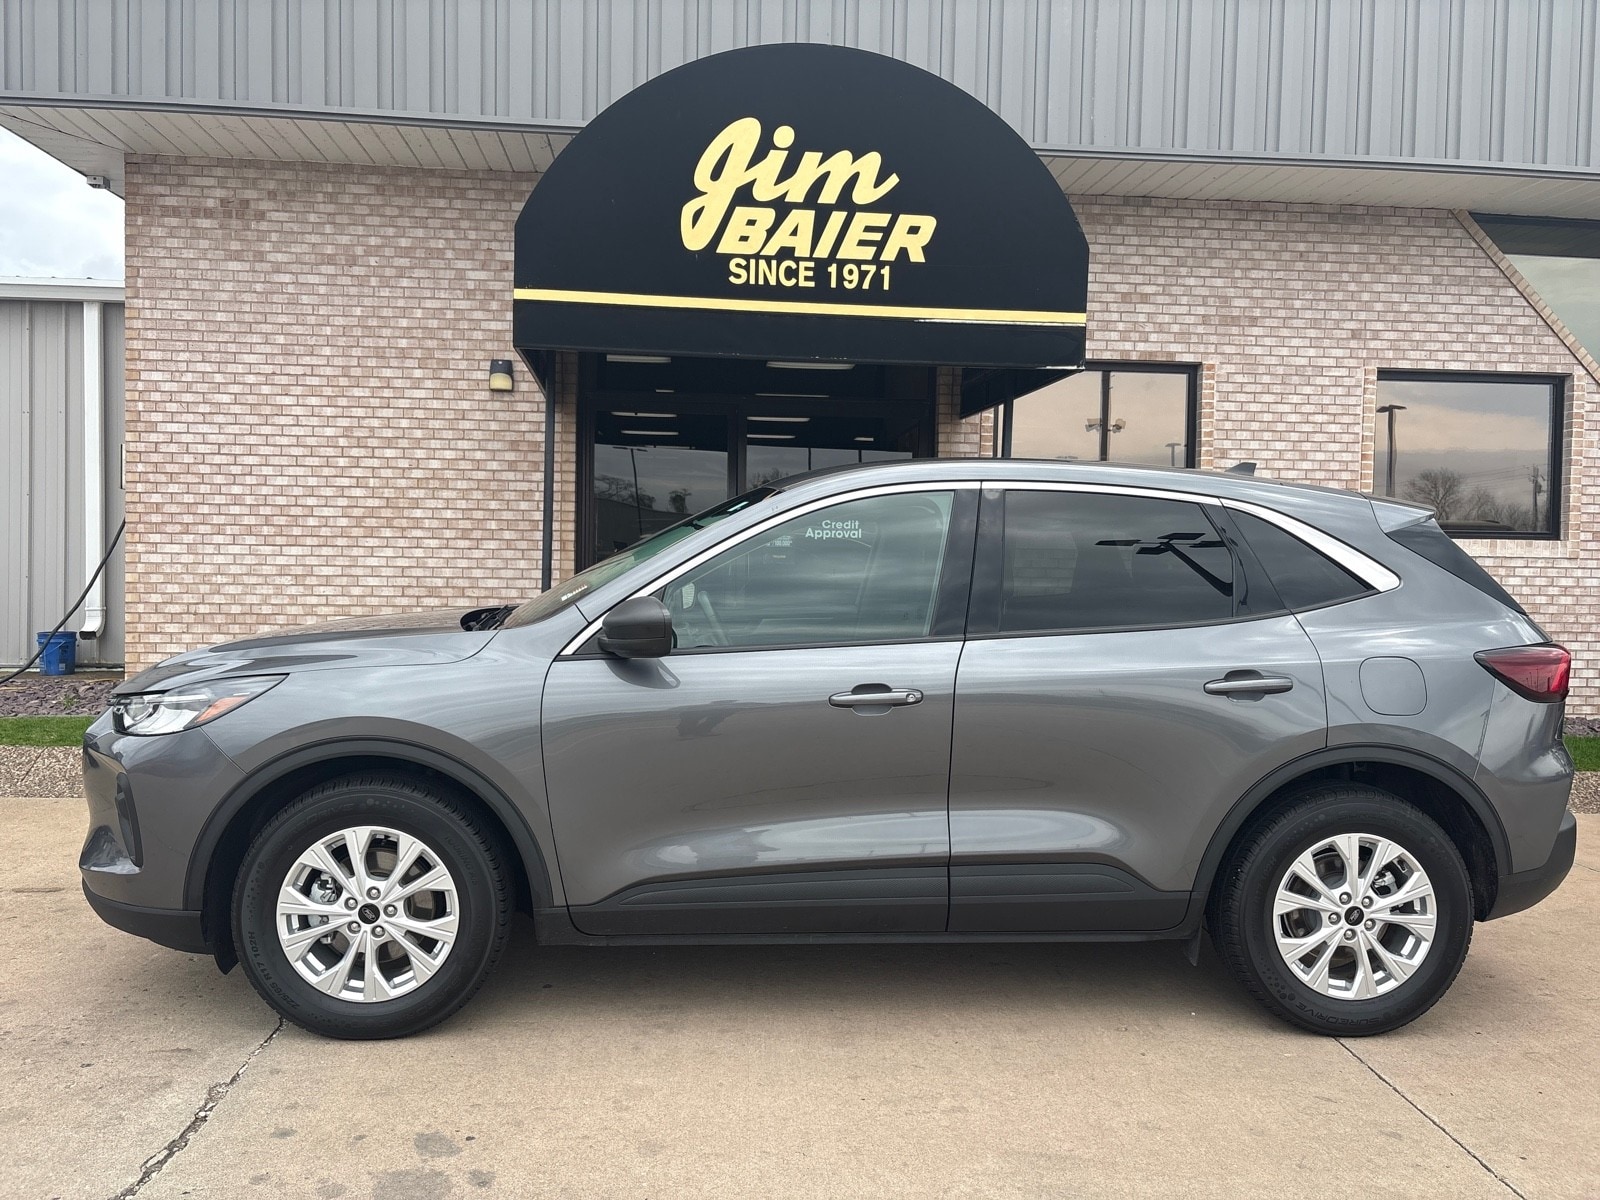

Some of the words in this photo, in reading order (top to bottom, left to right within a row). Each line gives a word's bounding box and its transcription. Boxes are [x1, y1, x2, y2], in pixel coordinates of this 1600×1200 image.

[681, 117, 900, 251] Jim
[716, 206, 937, 263] BAIER
[728, 258, 816, 287] SINCE
[827, 263, 891, 291] 1971
[805, 528, 862, 540] Approval
[822, 520, 860, 529] Credit
[247, 931, 260, 959] 102H
[256, 961, 273, 981] R17
[269, 982, 301, 1010] 225/65
[1295, 1001, 1380, 1026] SUREDRIVE
